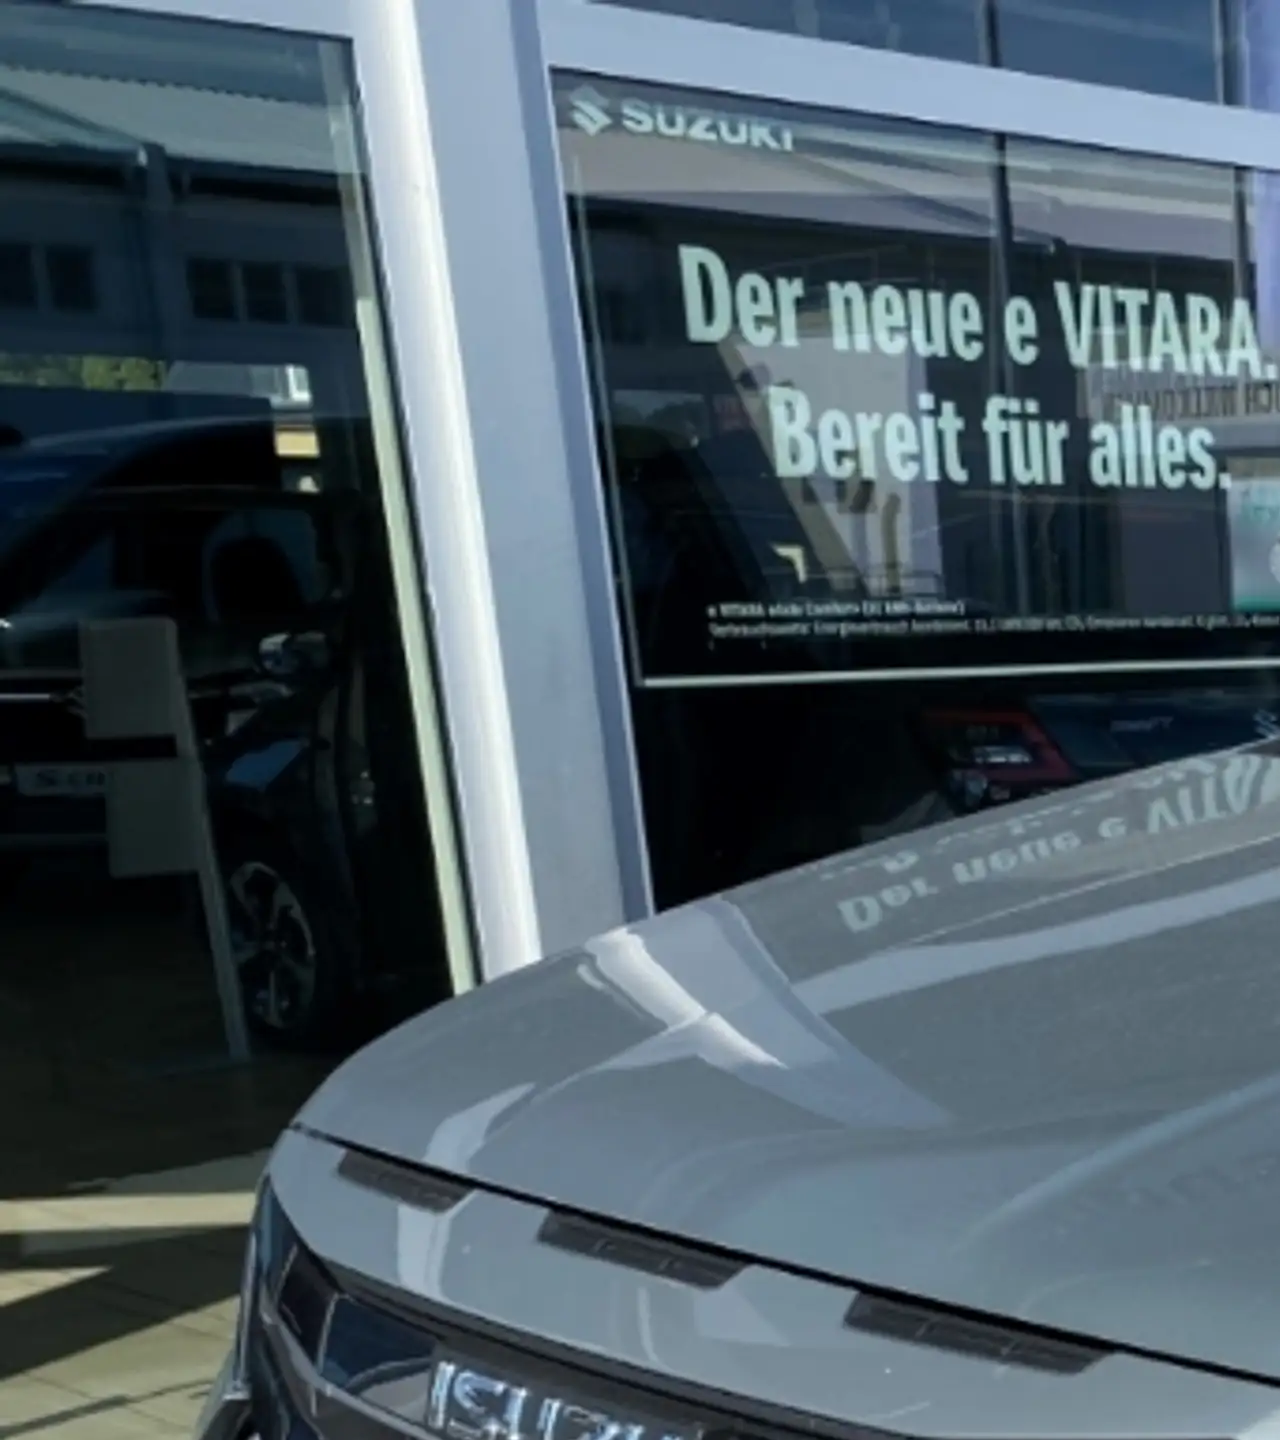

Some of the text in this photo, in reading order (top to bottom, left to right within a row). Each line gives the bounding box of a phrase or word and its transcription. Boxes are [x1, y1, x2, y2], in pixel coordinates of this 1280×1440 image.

[620, 97, 793, 152] SUZUKI
[678, 245, 1279, 381] Der neue e VITARA.
[767, 385, 1232, 491] Bereit für alles.
